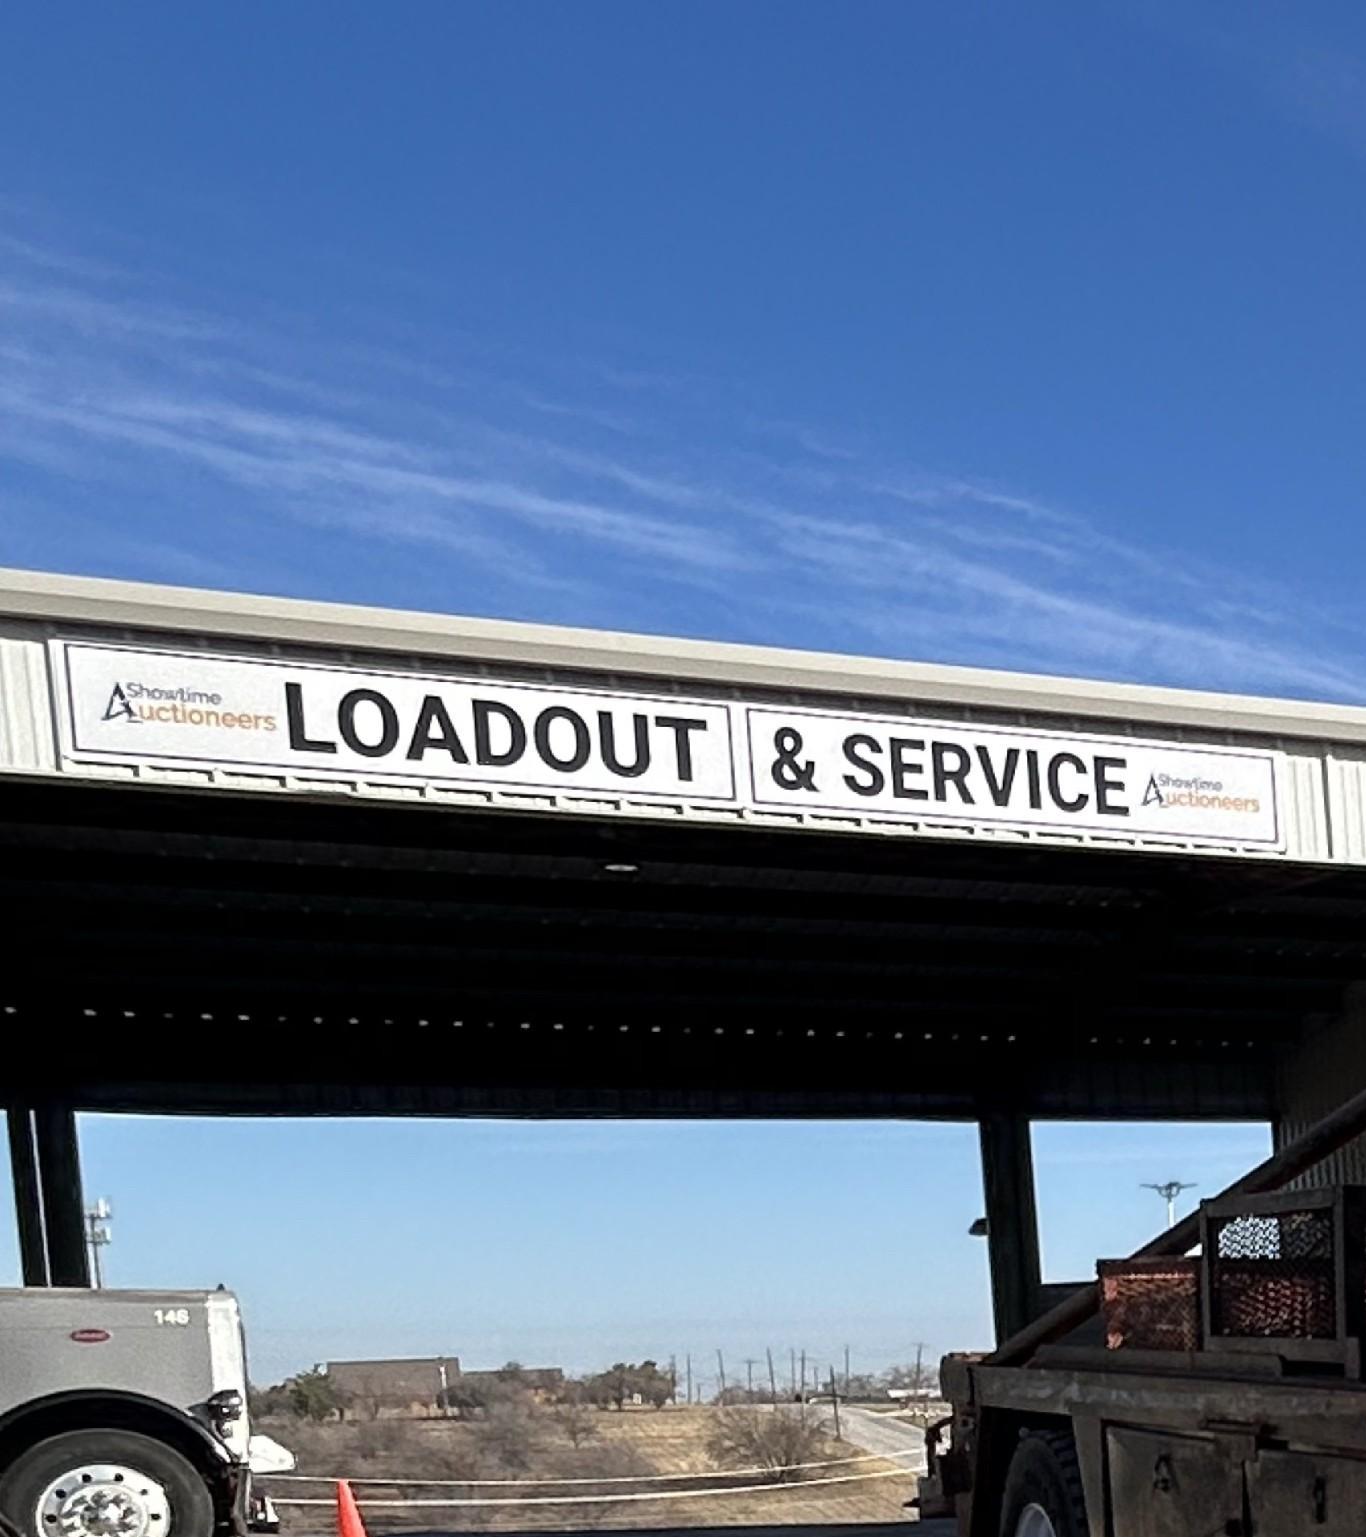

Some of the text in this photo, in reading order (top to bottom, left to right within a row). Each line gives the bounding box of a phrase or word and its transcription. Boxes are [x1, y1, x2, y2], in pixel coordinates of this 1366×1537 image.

[101, 682, 277, 731] Auctioneers
[126, 682, 222, 704] Showtime
[285, 682, 1130, 816] LOADOUT & SERVICE
